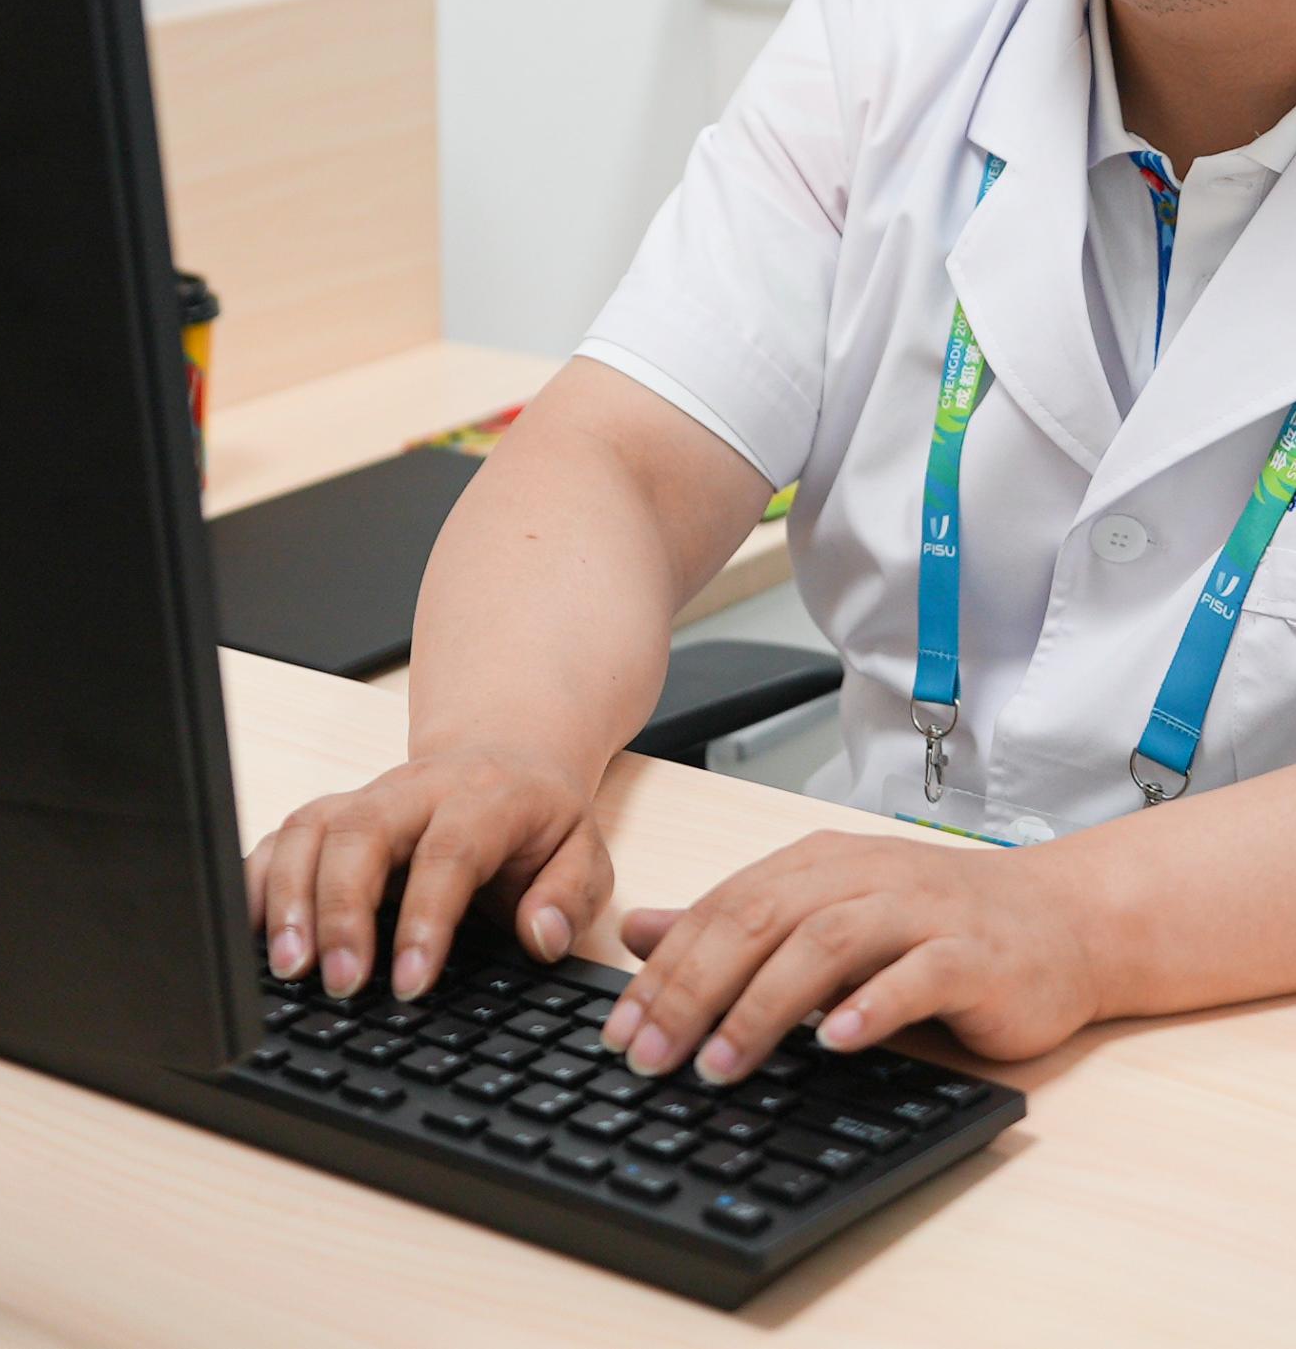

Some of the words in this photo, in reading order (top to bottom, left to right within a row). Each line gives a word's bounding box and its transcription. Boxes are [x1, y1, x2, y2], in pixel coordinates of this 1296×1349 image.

[942, 338, 964, 409] CHENGDU
[956, 336, 983, 409] 成都第
[923, 542, 956, 557] FISU
[1200, 592, 1235, 621] FISU
